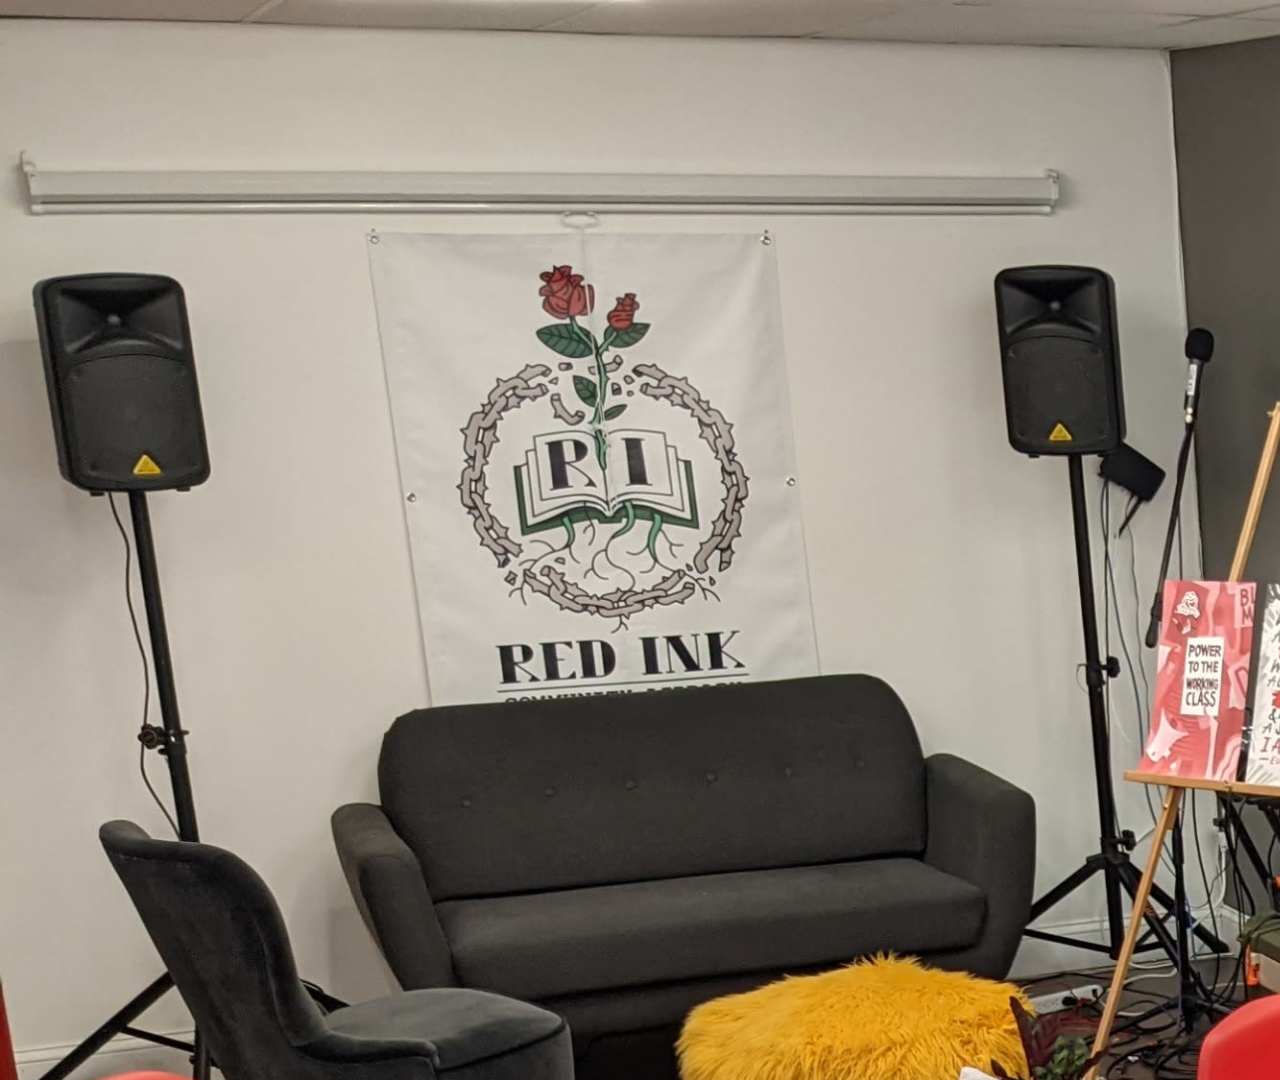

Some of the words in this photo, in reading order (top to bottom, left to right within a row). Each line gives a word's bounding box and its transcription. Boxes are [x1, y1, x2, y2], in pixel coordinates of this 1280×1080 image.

[545, 439, 597, 491] R
[624, 437, 654, 487] I
[1188, 644, 1221, 657] POWER
[495, 640, 617, 685] RED
[638, 631, 747, 677] INK
[1188, 661, 1200, 673] TO
[1201, 661, 1219, 673] THE
[1186, 678, 1219, 690] WORKING
[1186, 692, 1217, 708] CLASS
